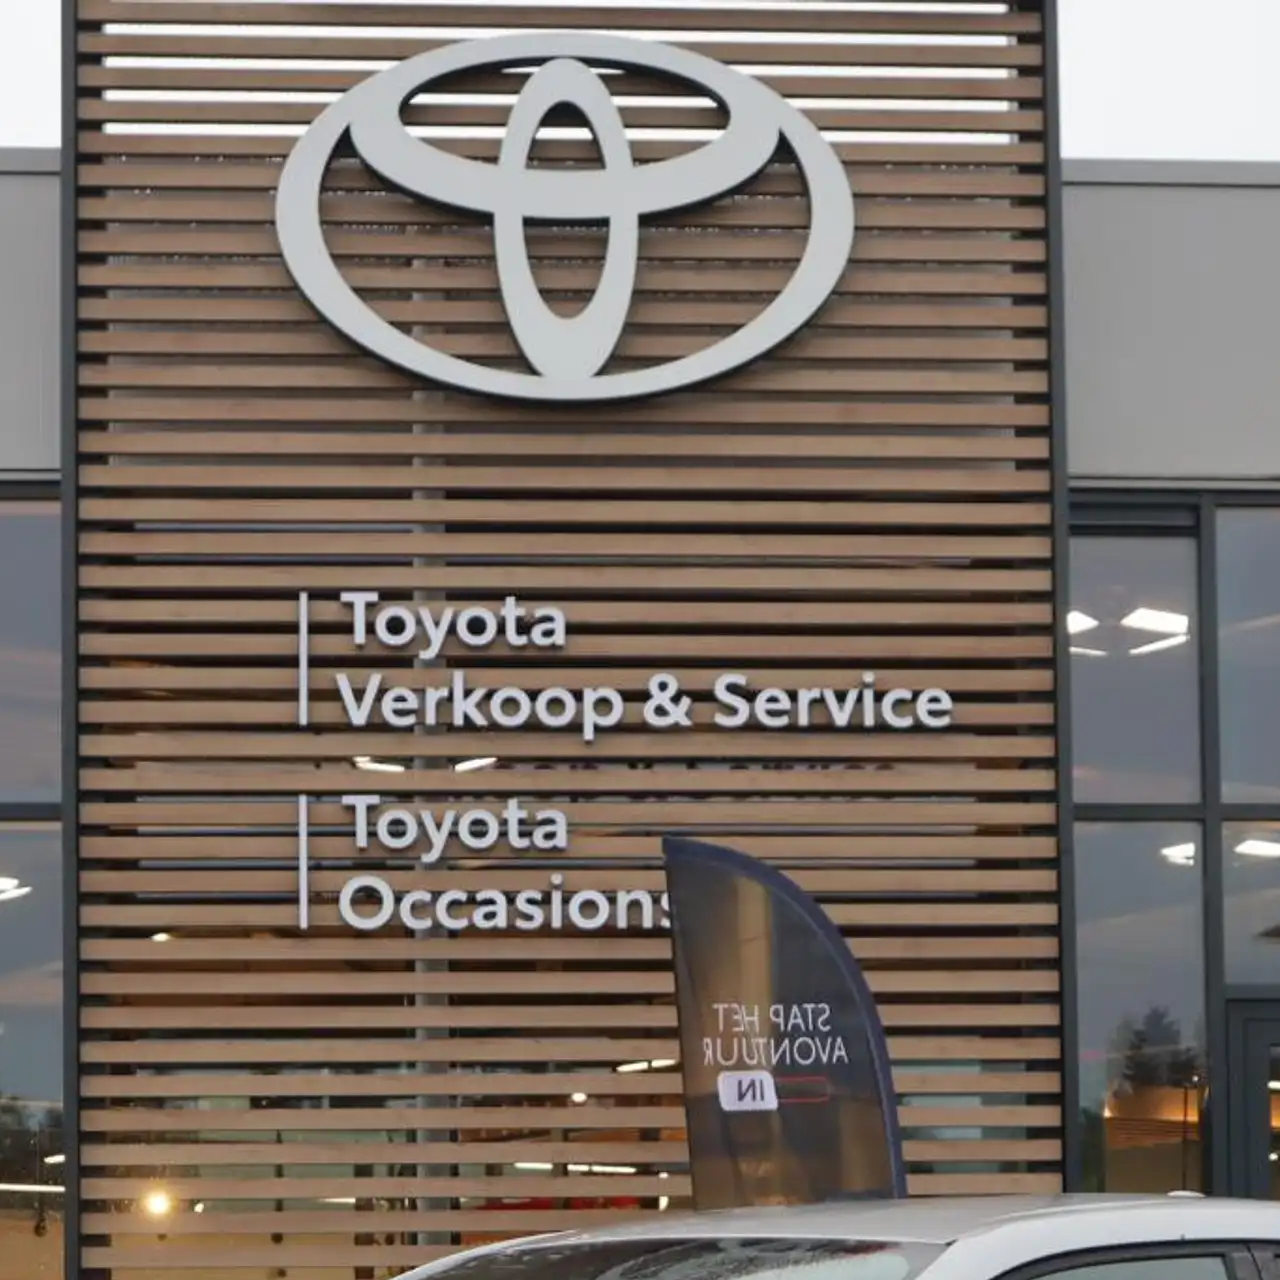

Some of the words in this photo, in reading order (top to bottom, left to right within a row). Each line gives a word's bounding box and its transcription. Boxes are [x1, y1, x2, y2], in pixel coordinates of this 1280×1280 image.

[340, 591, 566, 660] Toyota
[335, 669, 624, 742] Verkoop
[643, 672, 692, 727] &
[714, 671, 952, 728] Service
[341, 794, 567, 863] Toyota
